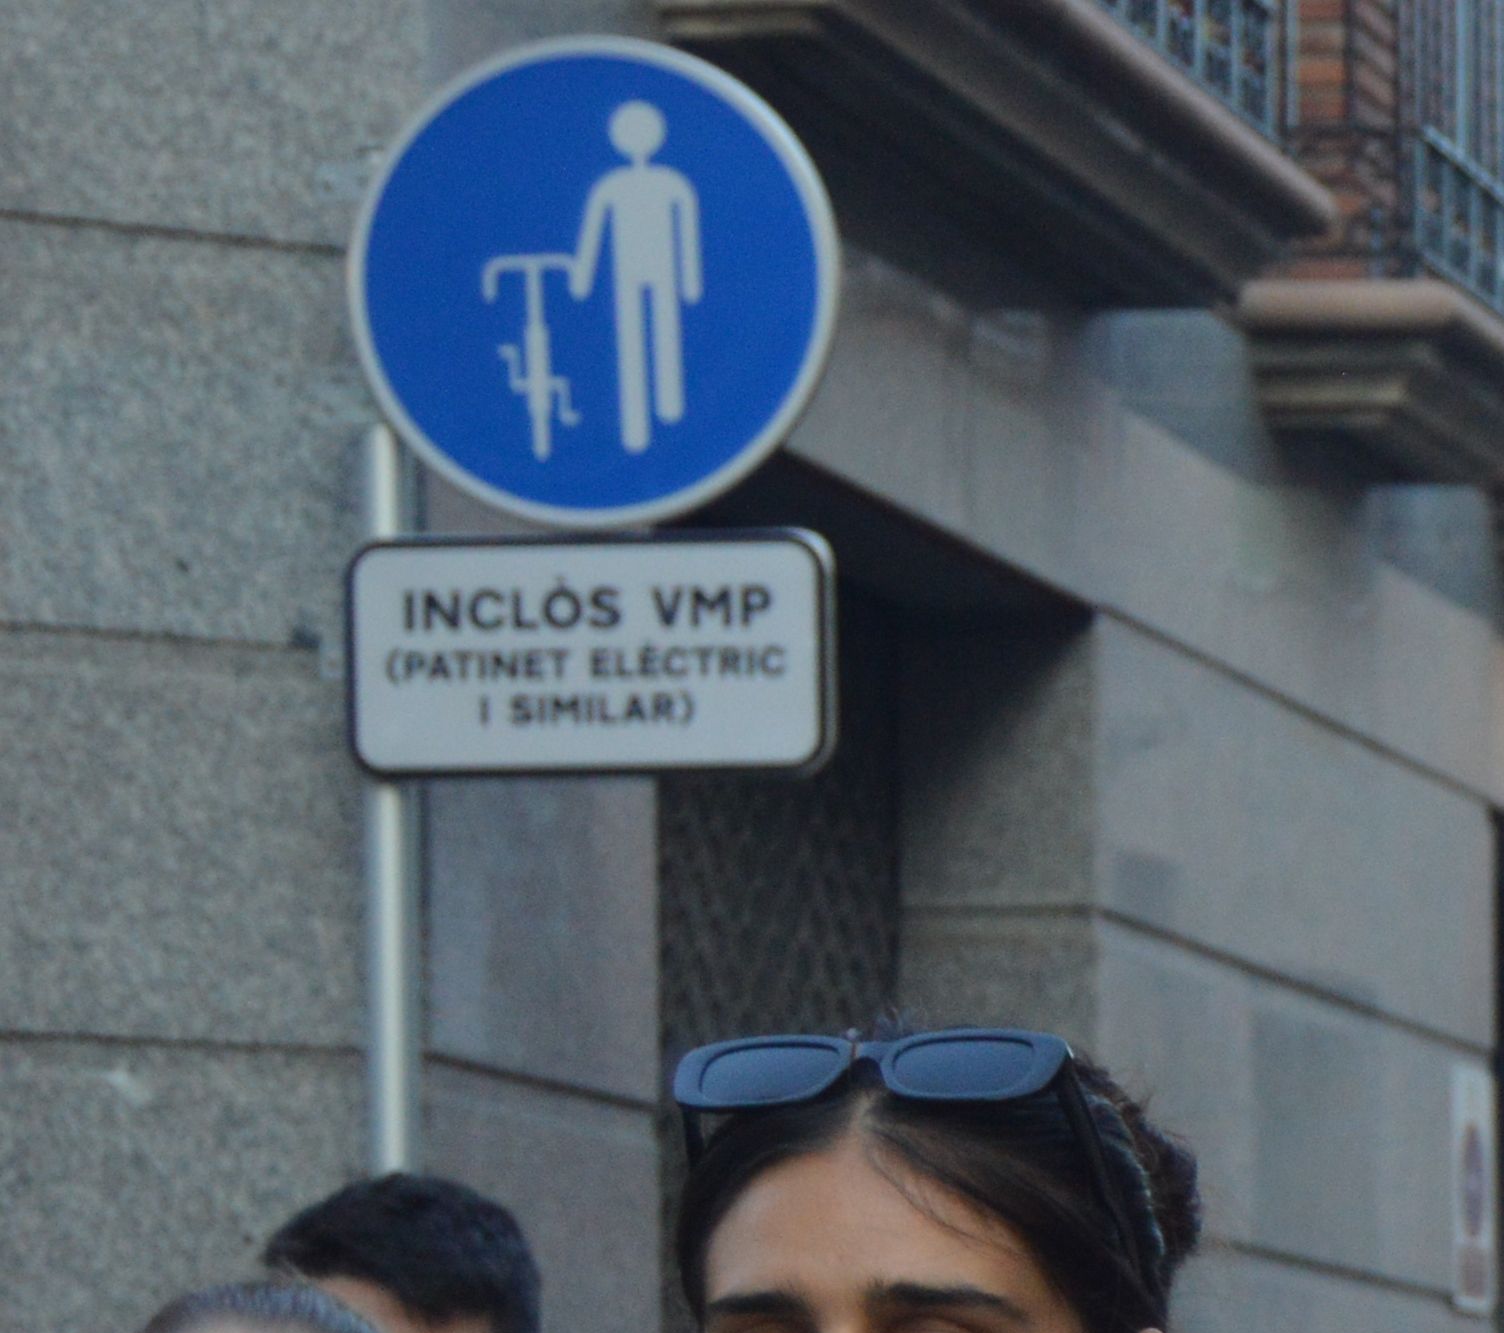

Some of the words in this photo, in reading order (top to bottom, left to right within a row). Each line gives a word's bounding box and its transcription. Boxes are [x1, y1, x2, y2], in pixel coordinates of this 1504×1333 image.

[403, 576, 622, 632] INCLÒS
[650, 585, 772, 628] VMP
[385, 646, 570, 684] (PATINET
[510, 691, 696, 726] SIMILAR)
